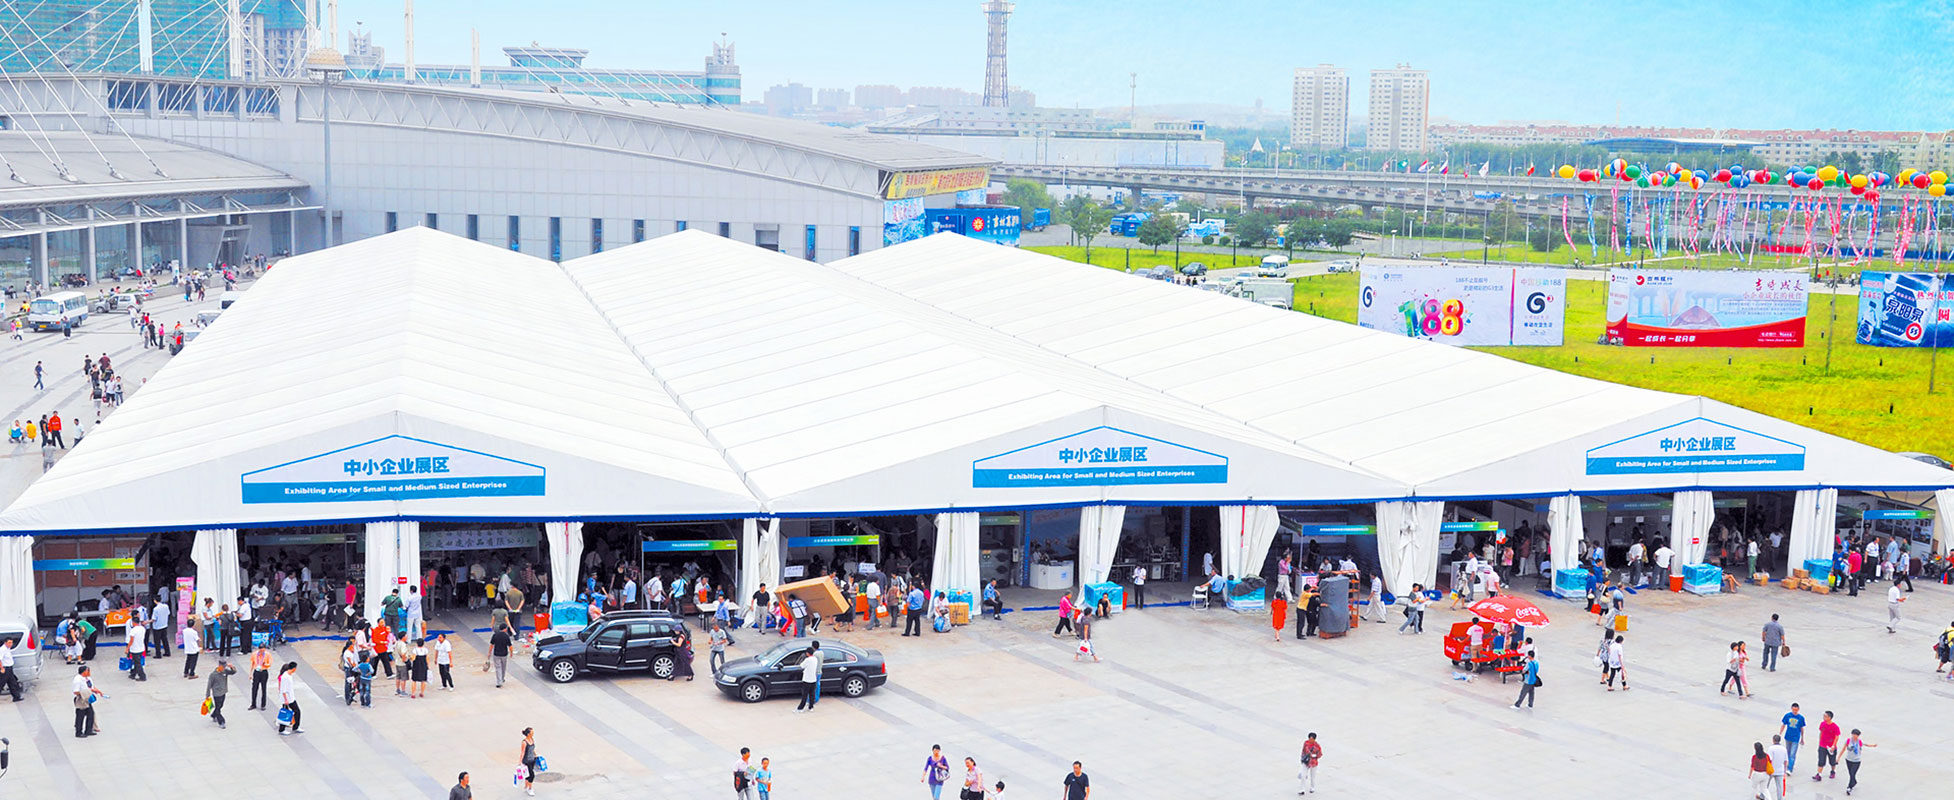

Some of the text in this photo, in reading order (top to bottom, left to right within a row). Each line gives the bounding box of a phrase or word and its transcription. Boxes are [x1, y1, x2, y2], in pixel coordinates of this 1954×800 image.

[1397, 298, 1464, 338] 188
[1887, 299, 1924, 323] 泉阳泉
[1661, 437, 1736, 452] 中小企业展区
[1059, 447, 1148, 463] 中小企业展区
[343, 456, 450, 476] 中小企业展区
[1008, 472, 1044, 480] Exhibiting
[1156, 470, 1195, 478] Enterprises
[285, 487, 326, 495] Exhibiting
[405, 484, 437, 492] Medium
[461, 481, 507, 490] Enterprises
